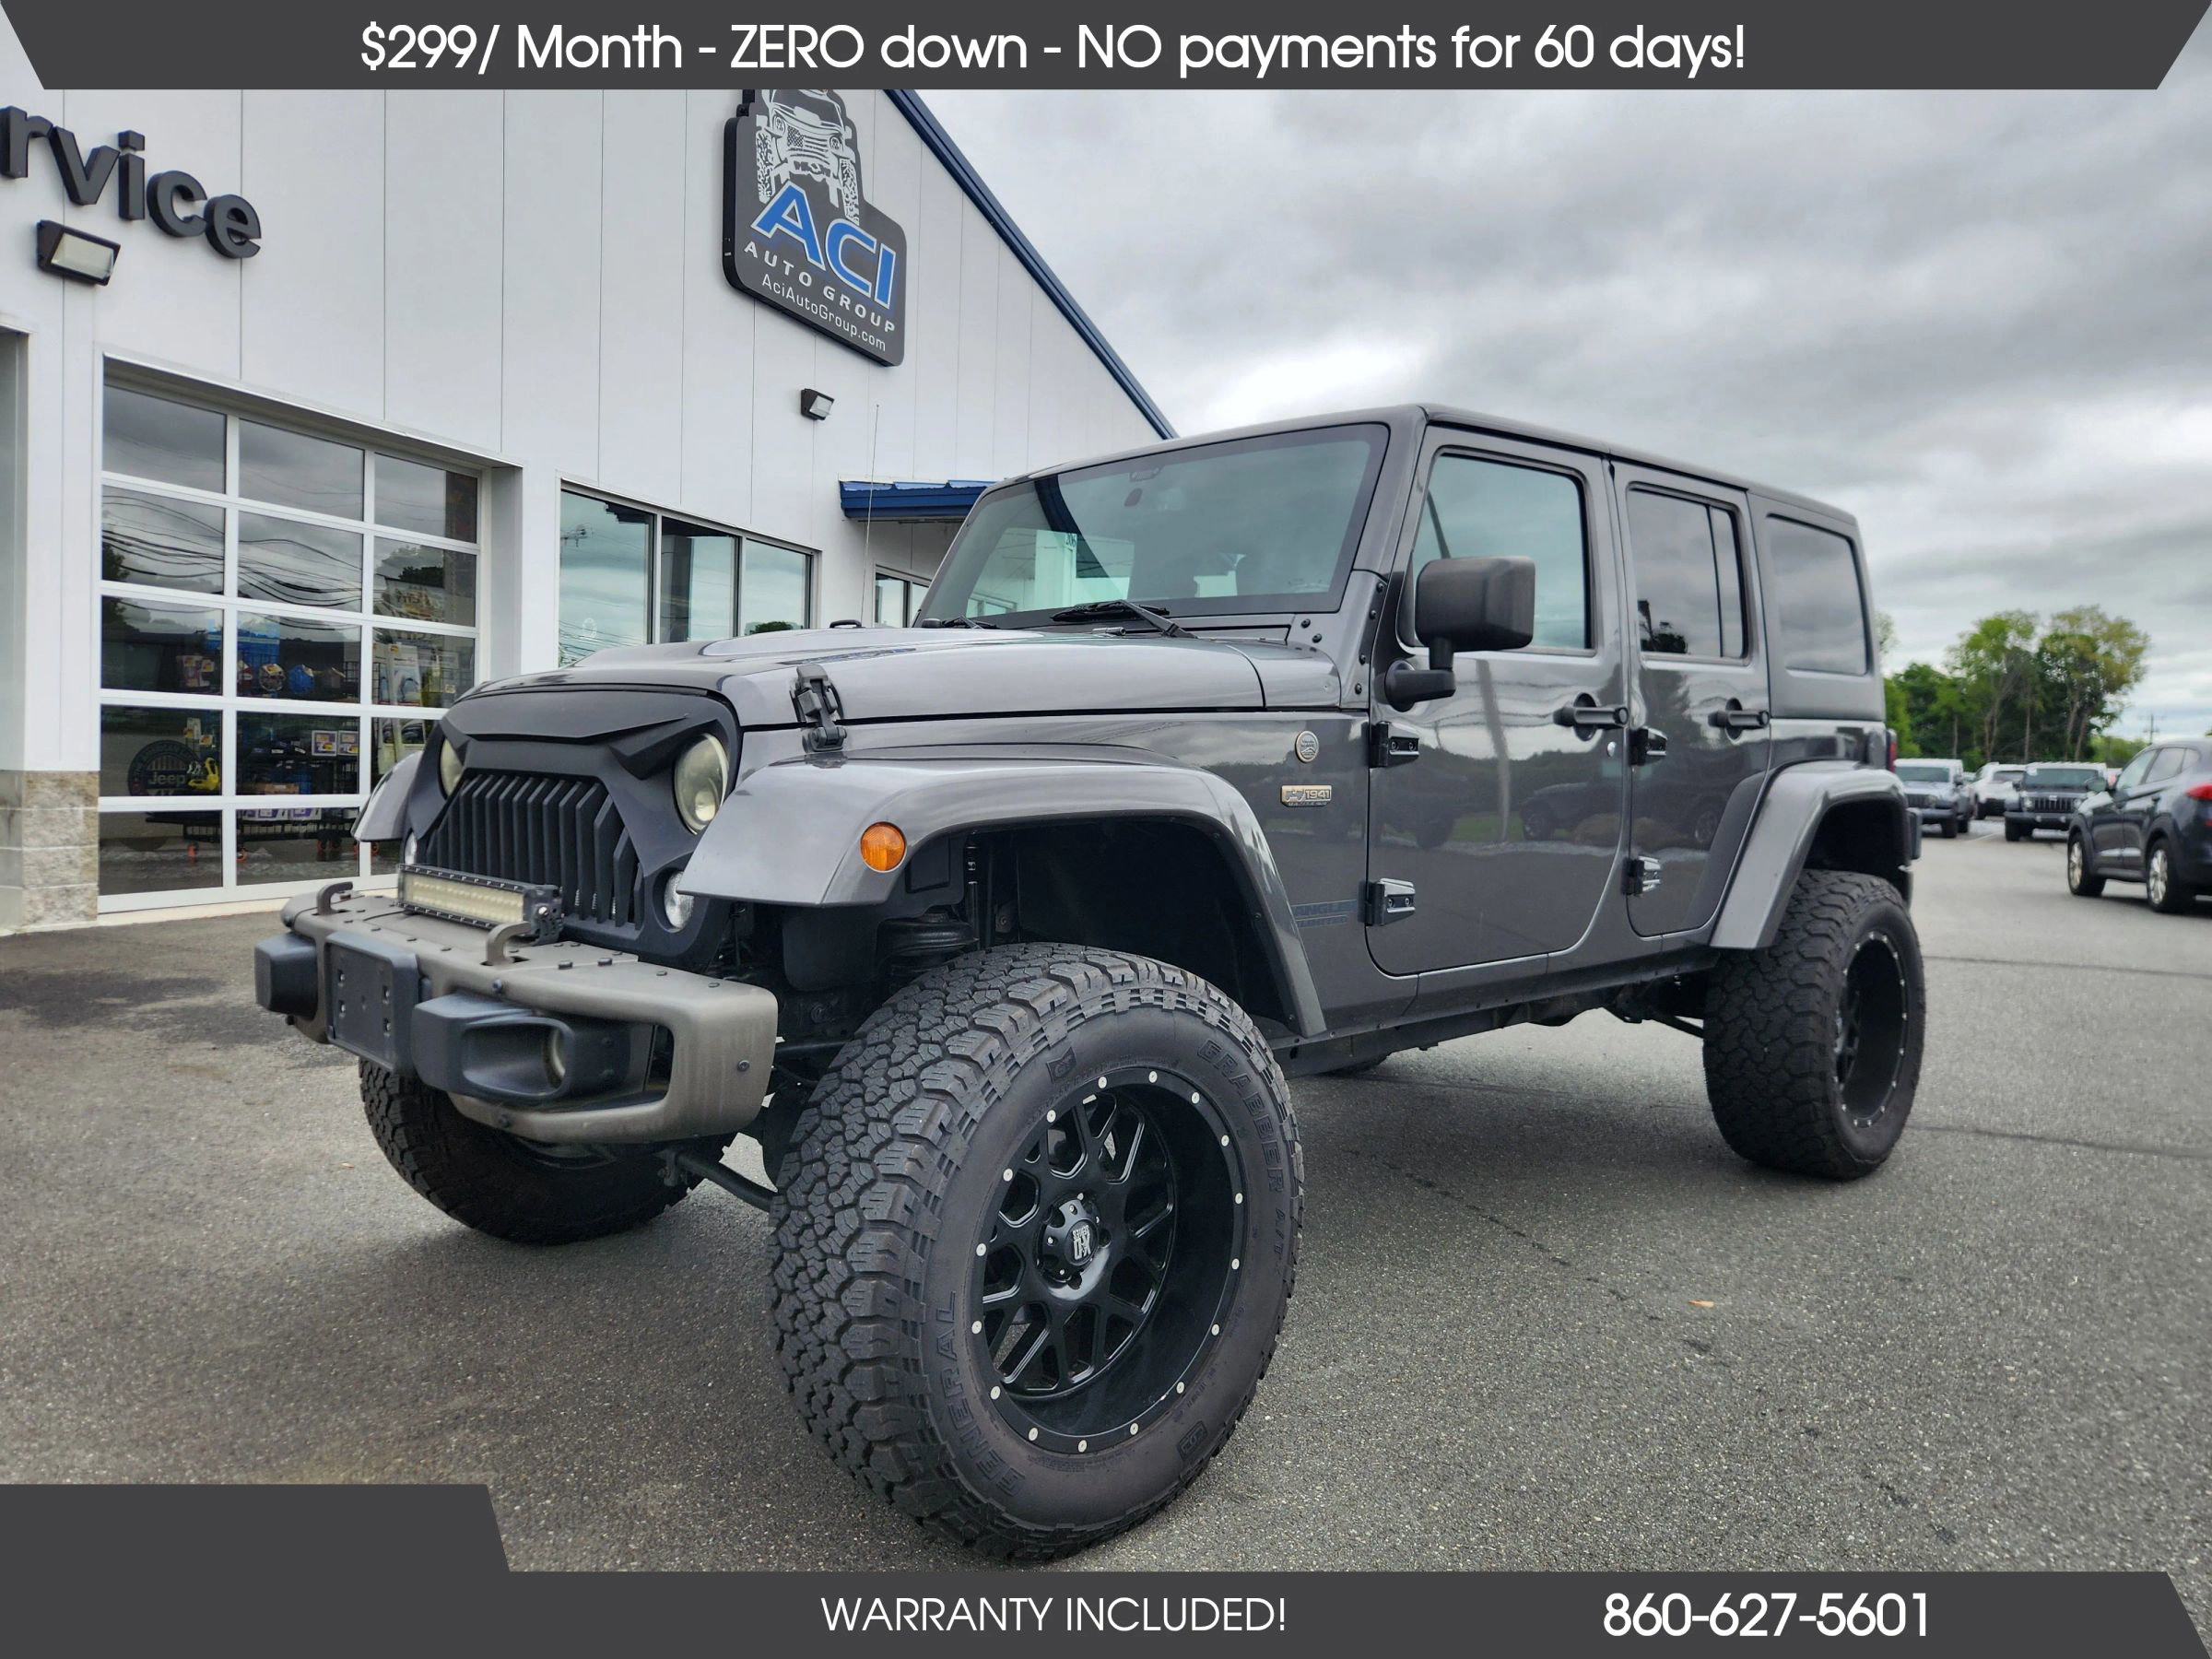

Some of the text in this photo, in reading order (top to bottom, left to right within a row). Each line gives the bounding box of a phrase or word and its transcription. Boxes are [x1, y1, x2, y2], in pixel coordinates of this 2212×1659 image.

[0, 105, 262, 259] rvice
[744, 241, 896, 333] AUTO GROUP
[751, 180, 897, 309] ACI
[762, 273, 886, 352] AciAutoGroup.com
[147, 771, 185, 787] Jeep
[1305, 790, 1330, 799] 1941
[1197, 1039, 1285, 1193] GRABBER
[936, 1290, 1025, 1496] GENERAL
